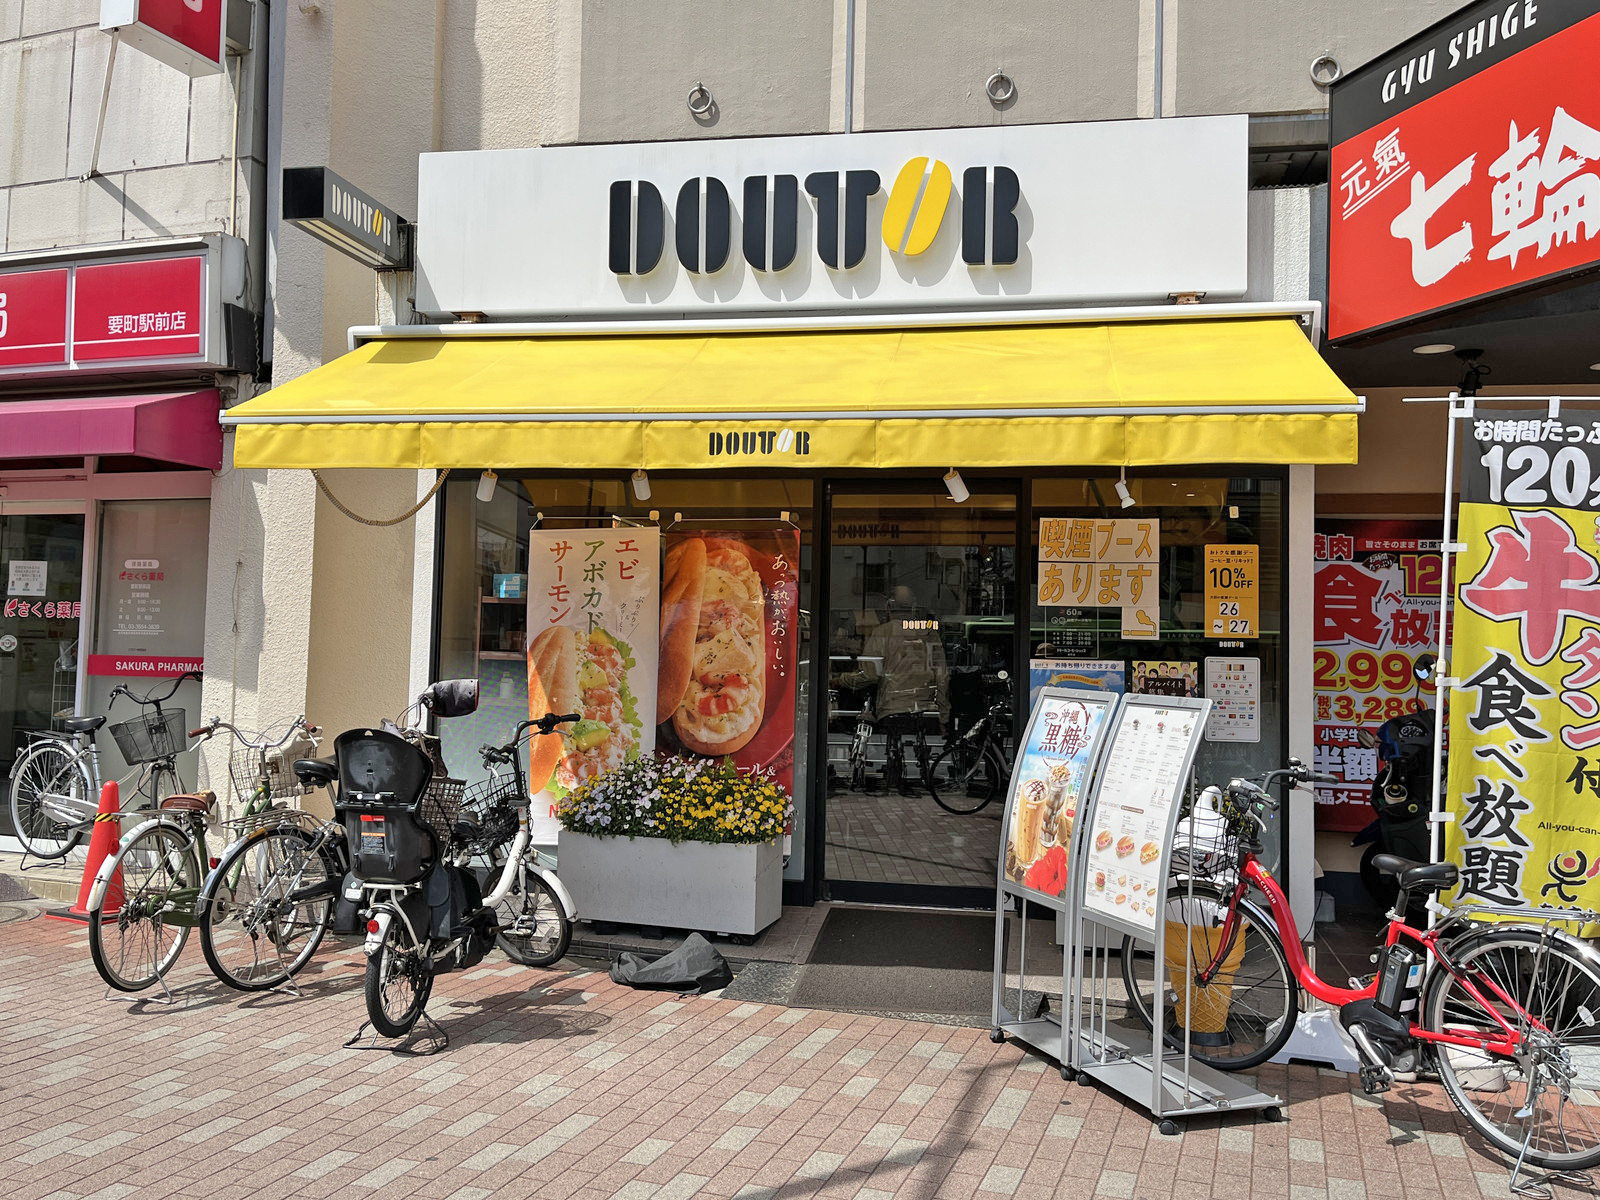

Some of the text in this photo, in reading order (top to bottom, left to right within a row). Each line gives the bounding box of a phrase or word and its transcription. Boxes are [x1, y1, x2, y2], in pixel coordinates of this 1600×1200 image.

[1381, 49, 1435, 104] GYU
[332, 184, 391, 246] DOUTOR
[609, 156, 1020, 275] DOUTOR
[1390, 106, 1600, 287] 七輪
[108, 311, 187, 335] 要町駅前店
[709, 428, 810, 455] DOUTOR
[1040, 519, 1153, 559] 喫煙ブース
[615, 539, 639, 580] エビ
[548, 541, 573, 624] サーモン
[581, 540, 606, 634] アボカド
[1039, 564, 1152, 604] あります
[1234, 580, 1253, 588] OFF
[18, 601, 81, 618] さくら薬局
[903, 620, 939, 630] DOUTOR
[1220, 602, 1238, 615] 26
[115, 662, 155, 671] SAKURA
[1456, 652, 1553, 907] 食べ放題
